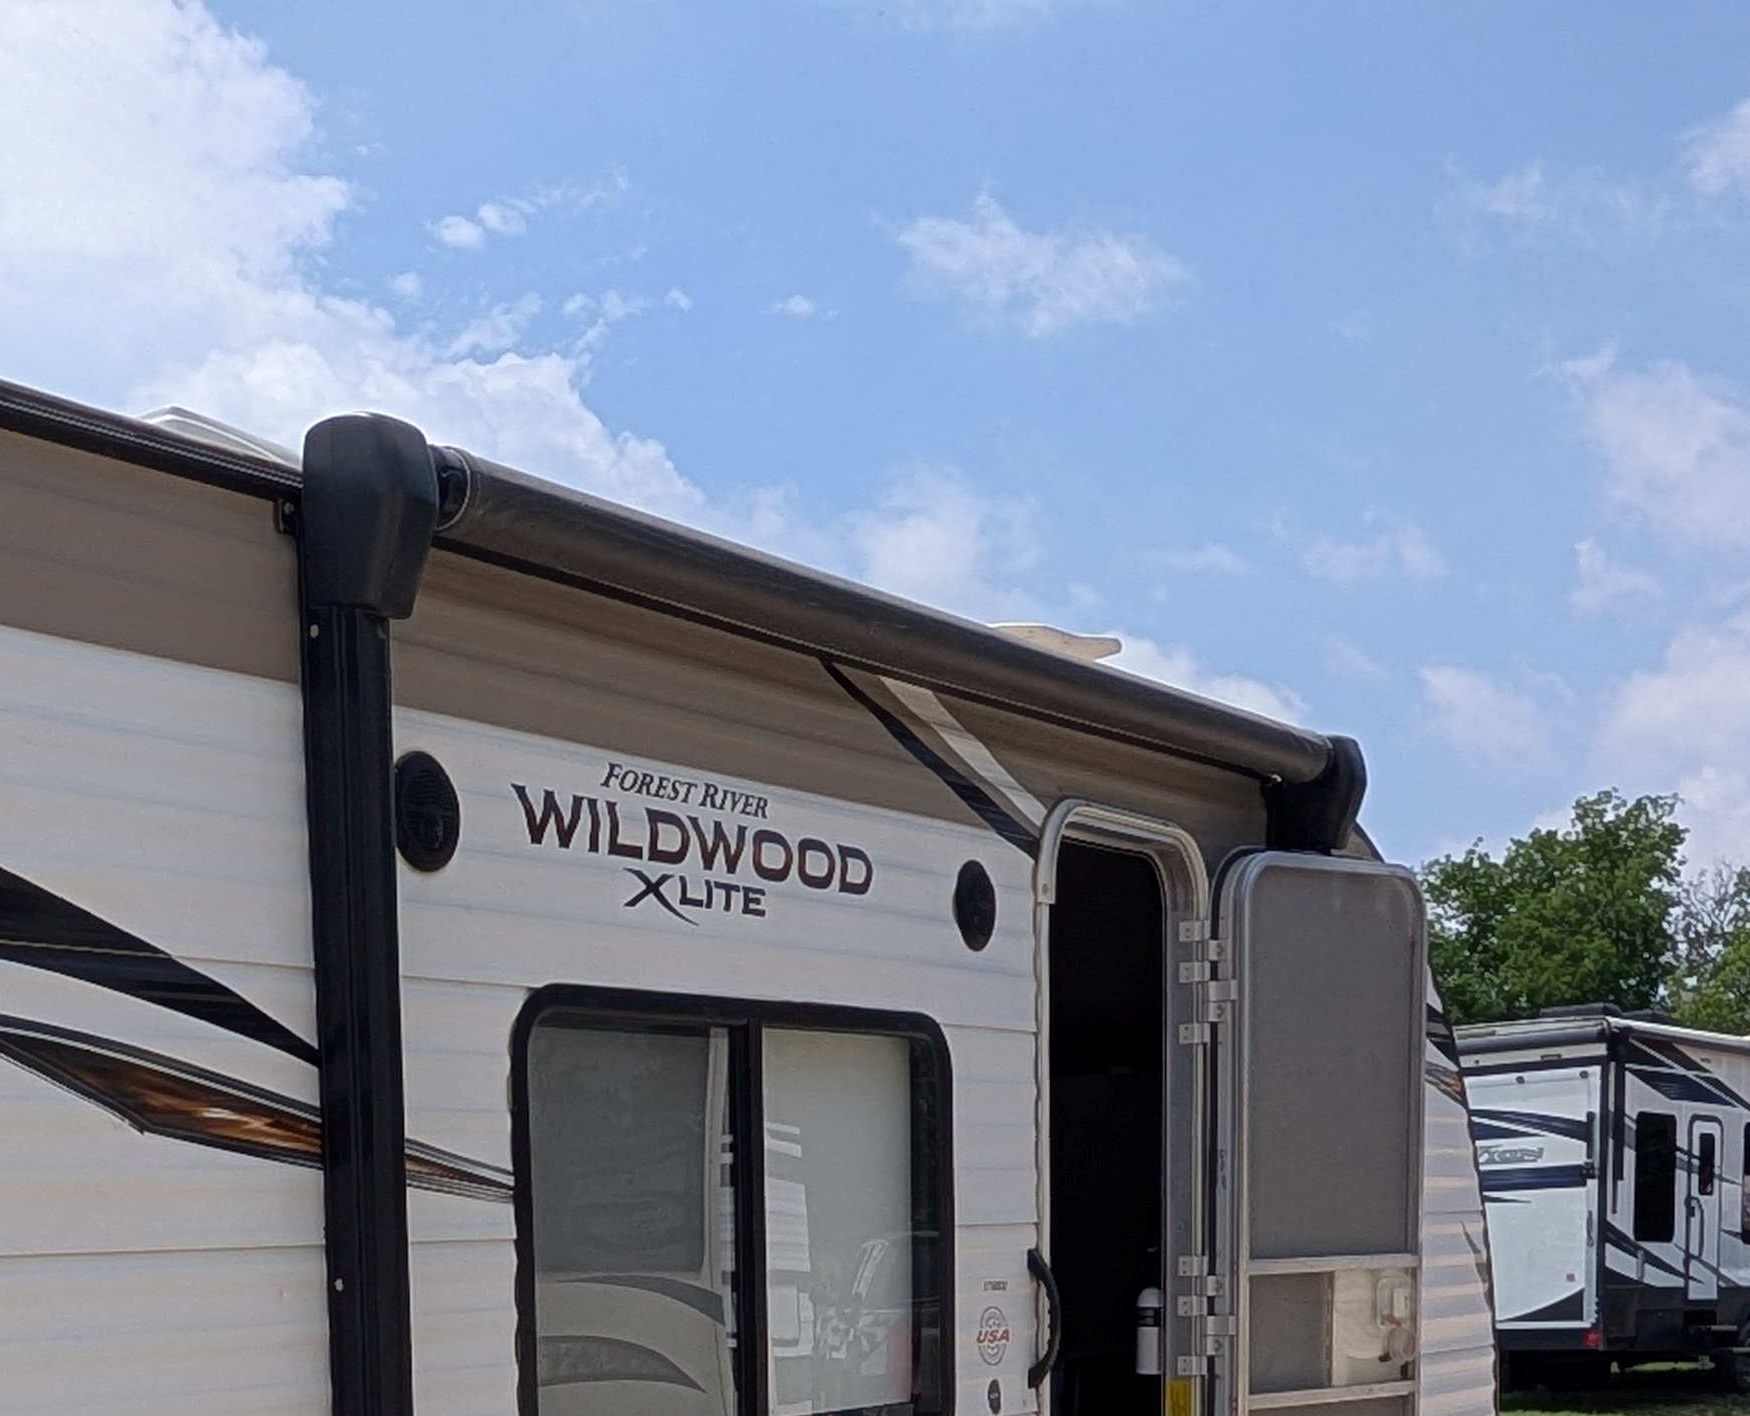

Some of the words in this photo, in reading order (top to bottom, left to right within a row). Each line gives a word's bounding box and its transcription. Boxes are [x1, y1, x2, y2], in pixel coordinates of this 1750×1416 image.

[600, 762, 697, 804] FOREST
[701, 783, 768, 820] RIVER
[511, 783, 874, 896] WILDWOOD
[976, 1328, 1010, 1344] USA
